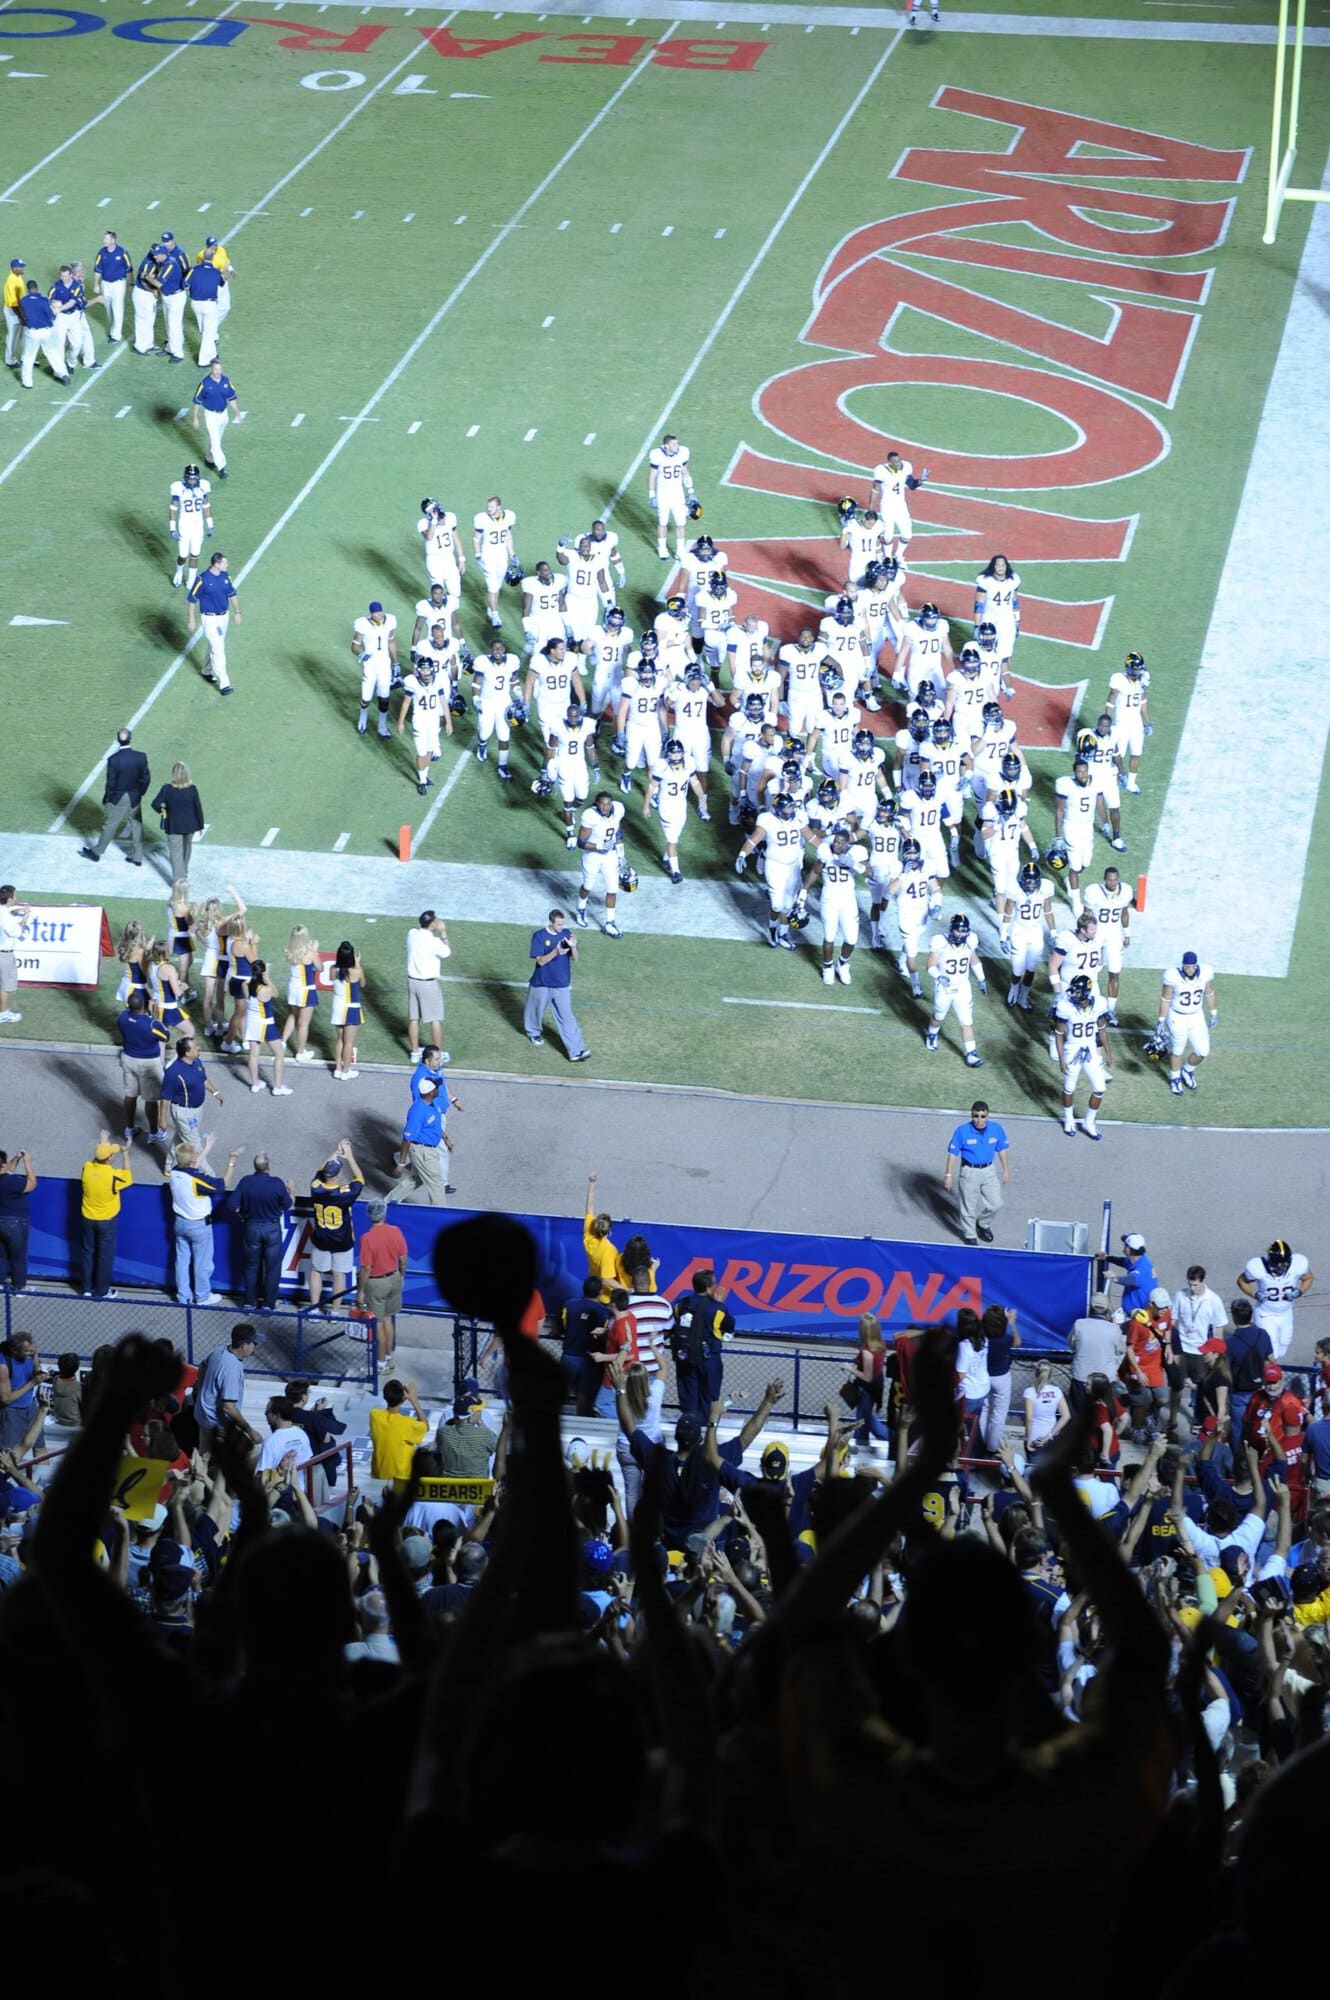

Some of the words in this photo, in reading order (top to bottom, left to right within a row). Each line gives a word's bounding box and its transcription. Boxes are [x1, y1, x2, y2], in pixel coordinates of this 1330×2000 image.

[208, 15, 777, 72] BEAR
[892, 482, 900, 495] 4
[437, 533, 452, 549] 13
[862, 538, 873, 552] 11
[576, 570, 592, 586] 61
[540, 594, 559, 611] 53
[993, 591, 1013, 606] 44
[377, 635, 383, 651] 1
[836, 636, 857, 652] 76
[919, 638, 940, 655] 70
[602, 646, 620, 663] 31
[796, 663, 818, 680] 97
[494, 675, 505, 692] 3
[546, 675, 568, 691] 98
[418, 694, 437, 710] 40
[964, 687, 984, 705] 75
[1126, 693, 1140, 708] 15
[682, 701, 704, 718] 47
[833, 728, 849, 744] 10
[568, 740, 579, 756] 8
[986, 741, 1007, 759] 72
[857, 771, 876, 787] 18
[667, 781, 688, 797] 34
[1079, 796, 1090, 813] 5
[920, 809, 938, 827] 10
[603, 827, 615, 843] 9
[776, 829, 799, 847] 92
[1000, 823, 1018, 842] 17
[827, 865, 849, 883] 95
[906, 880, 929, 900] 42
[1020, 903, 1041, 921] 20
[945, 957, 969, 975] 39
[1076, 950, 1099, 970] 76
[1179, 988, 1203, 1007] 33
[1071, 1021, 1095, 1039] 86
[314, 1203, 344, 1230] 10
[660, 1255, 985, 1323] ARIZONA
[429, 1484, 483, 1499] BEARS!
[922, 1492, 945, 1523] 9
[1151, 1524, 1177, 1537] BEA
